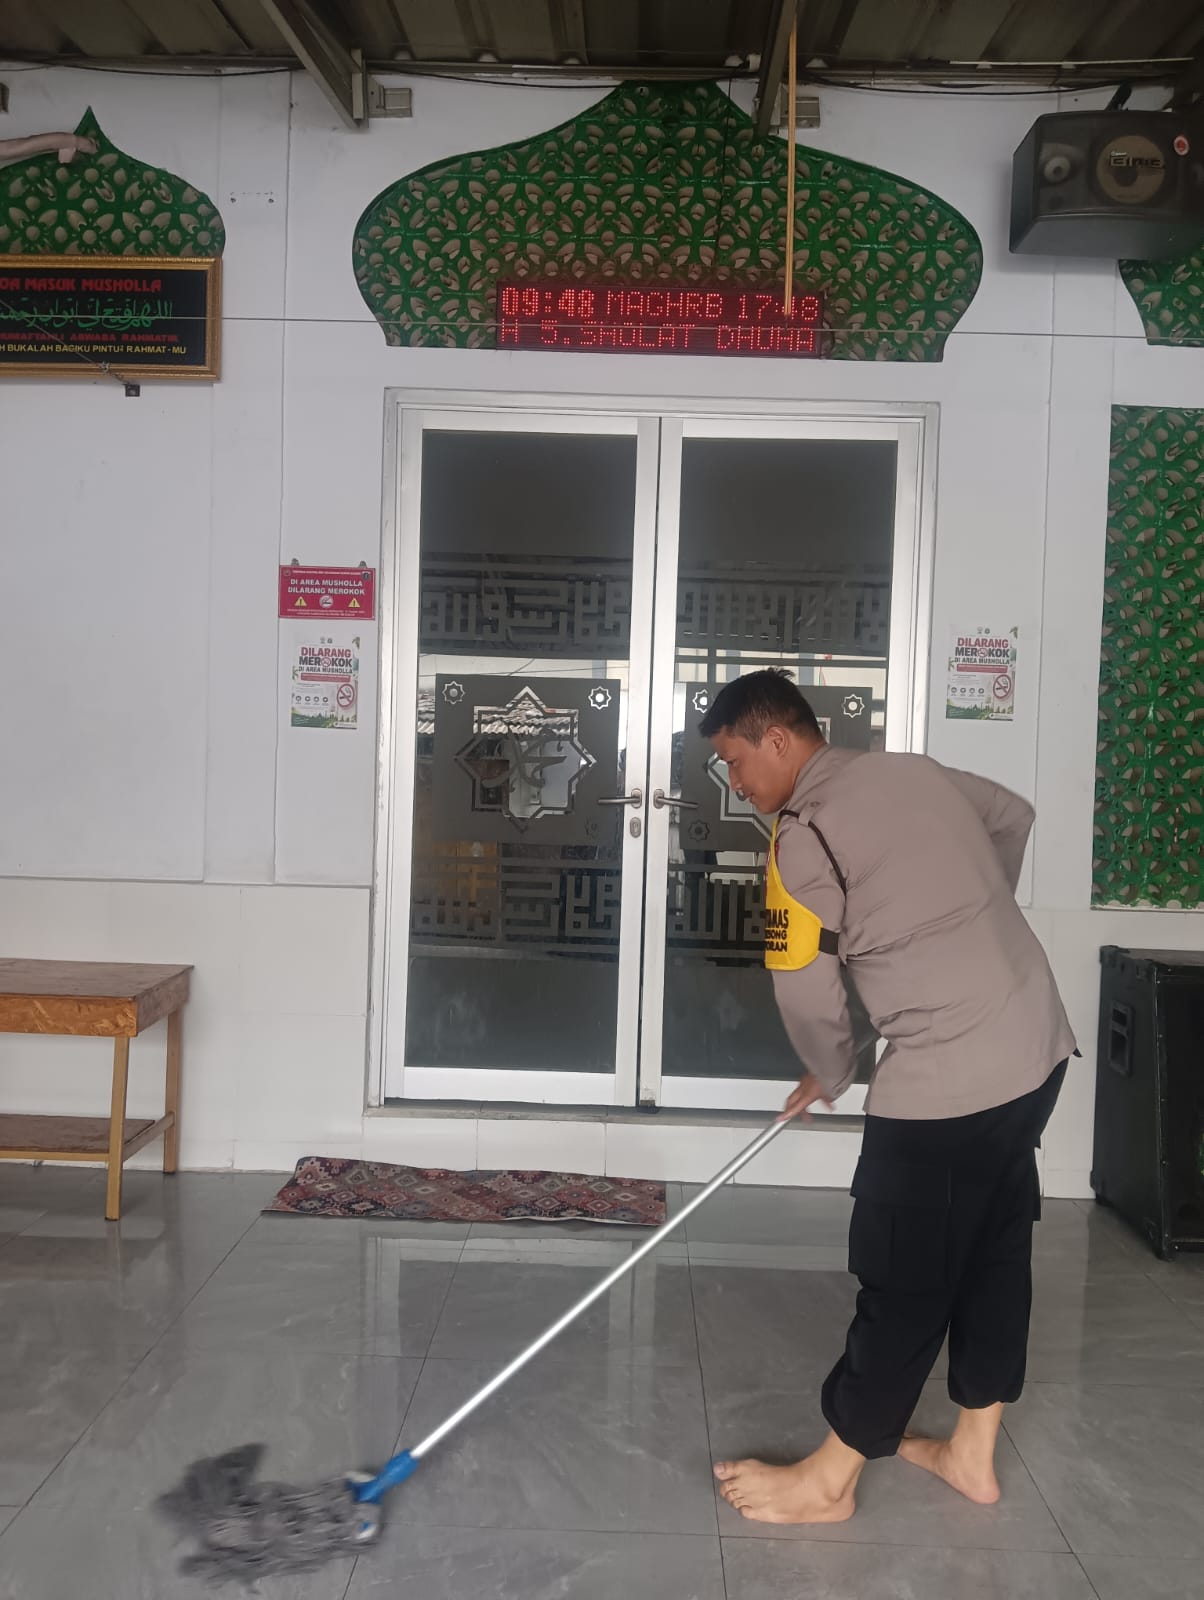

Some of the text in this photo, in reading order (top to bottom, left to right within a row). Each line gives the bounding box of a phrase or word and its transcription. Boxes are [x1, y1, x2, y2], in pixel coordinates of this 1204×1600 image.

[25, 277, 76, 292] MASUK
[81, 278, 161, 293] MUSHOLLA
[502, 287, 595, 317] 09:48
[607, 290, 723, 318] MAGHRB
[717, 324, 813, 351] DHUHA
[7, 343, 54, 352] BUKALAH
[55, 344, 90, 353] BAGIKU
[321, 579, 363, 587] MUSHOLLA
[957, 638, 1009, 648] DILARANG
[301, 647, 351, 658] DILARANG
